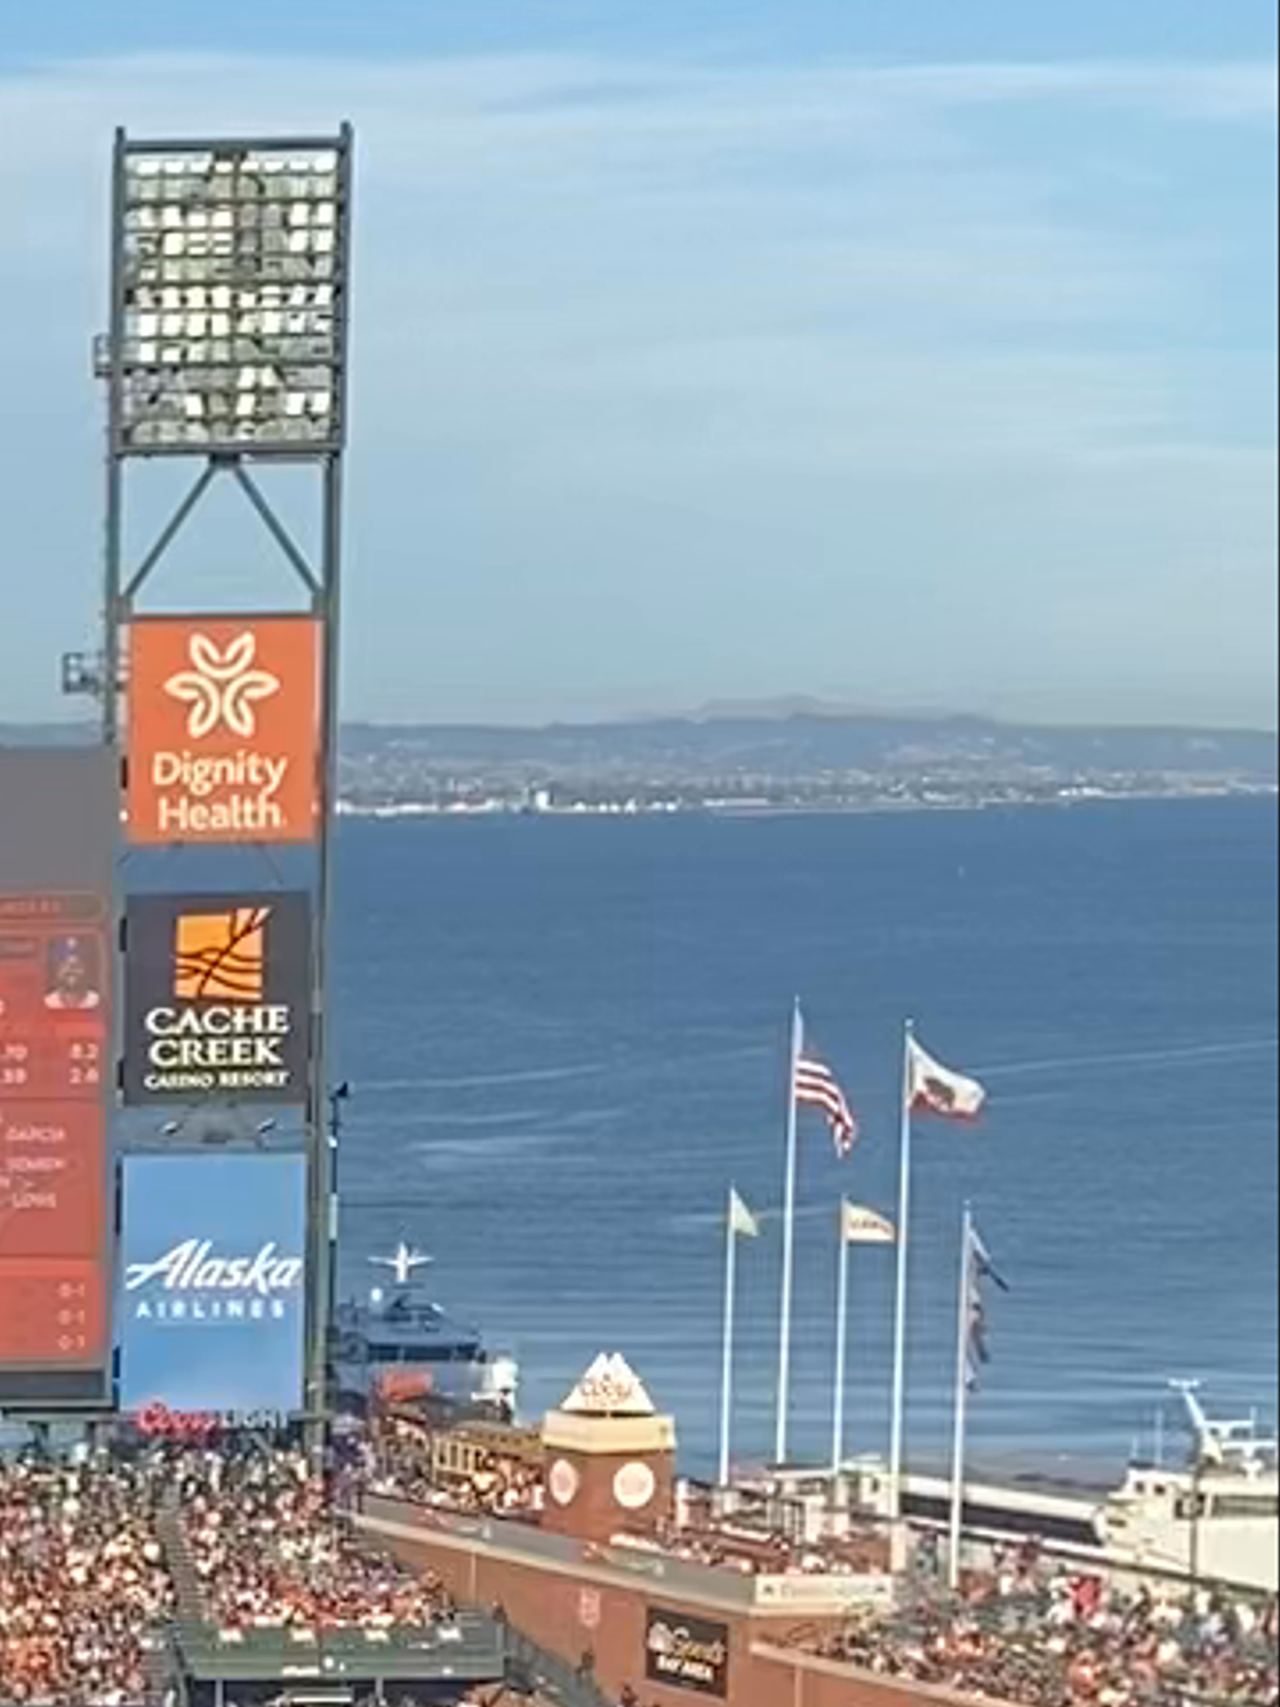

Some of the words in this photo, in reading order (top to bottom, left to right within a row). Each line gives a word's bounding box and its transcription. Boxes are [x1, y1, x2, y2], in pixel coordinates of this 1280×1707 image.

[152, 751, 287, 795] Dignity
[158, 796, 282, 830] Health
[144, 1006, 289, 1035] CACHE
[148, 1038, 284, 1067] CREEK
[144, 1072, 215, 1090] CASINO
[219, 1070, 289, 1089] RESORT
[126, 1238, 303, 1294] Alaska
[136, 1299, 286, 1318] AIRLINES
[136, 1401, 217, 1432] Coors
[220, 1407, 289, 1430] LIGHT
